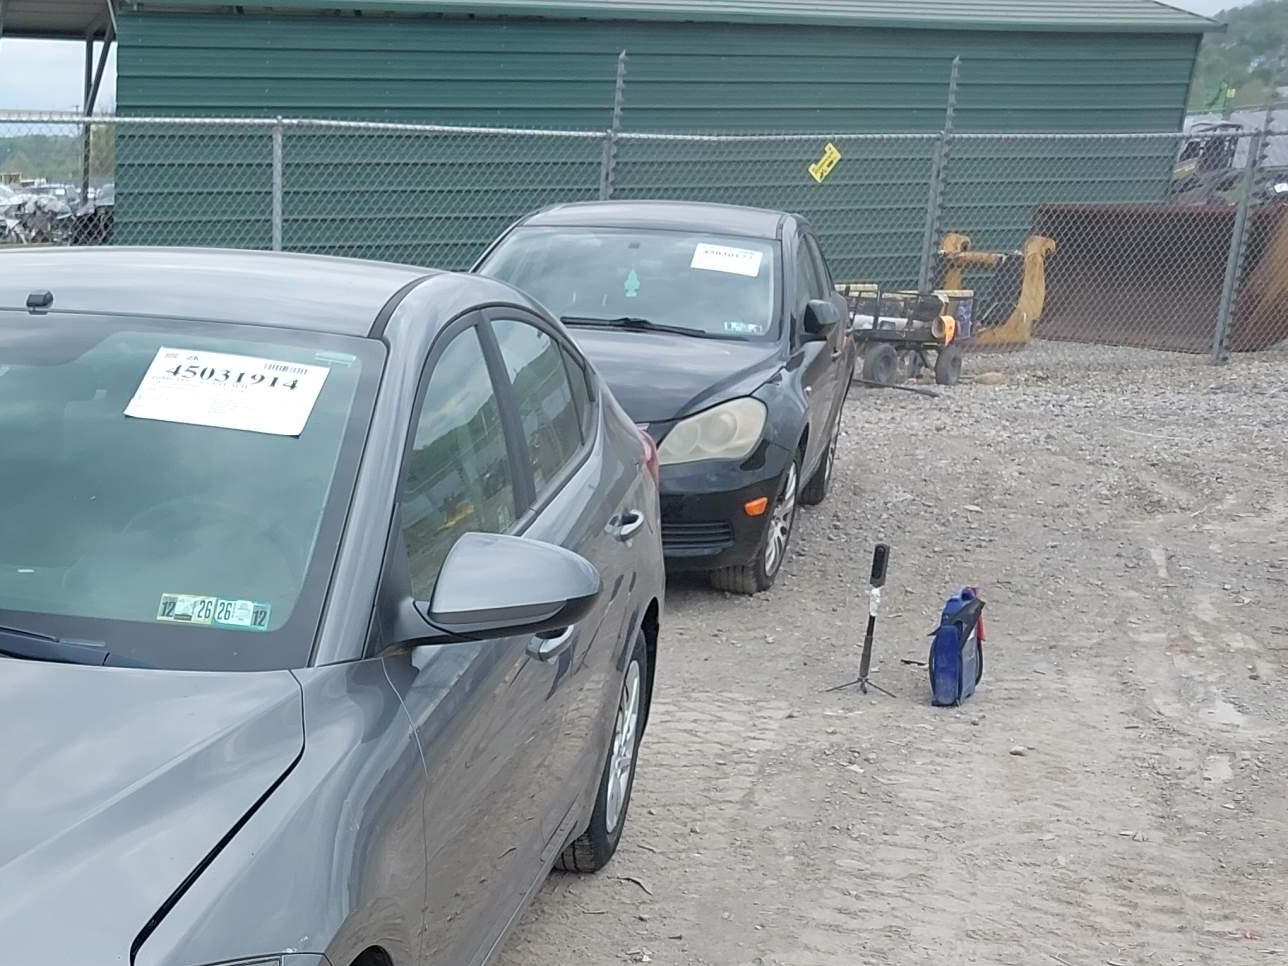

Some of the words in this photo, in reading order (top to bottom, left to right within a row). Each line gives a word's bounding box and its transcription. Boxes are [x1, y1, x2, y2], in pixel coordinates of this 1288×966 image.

[166, 364, 299, 390] 45031914
[162, 602, 176, 617] 12
[198, 600, 213, 618] 26
[217, 602, 232, 620] 26
[253, 610, 267, 626] 12
